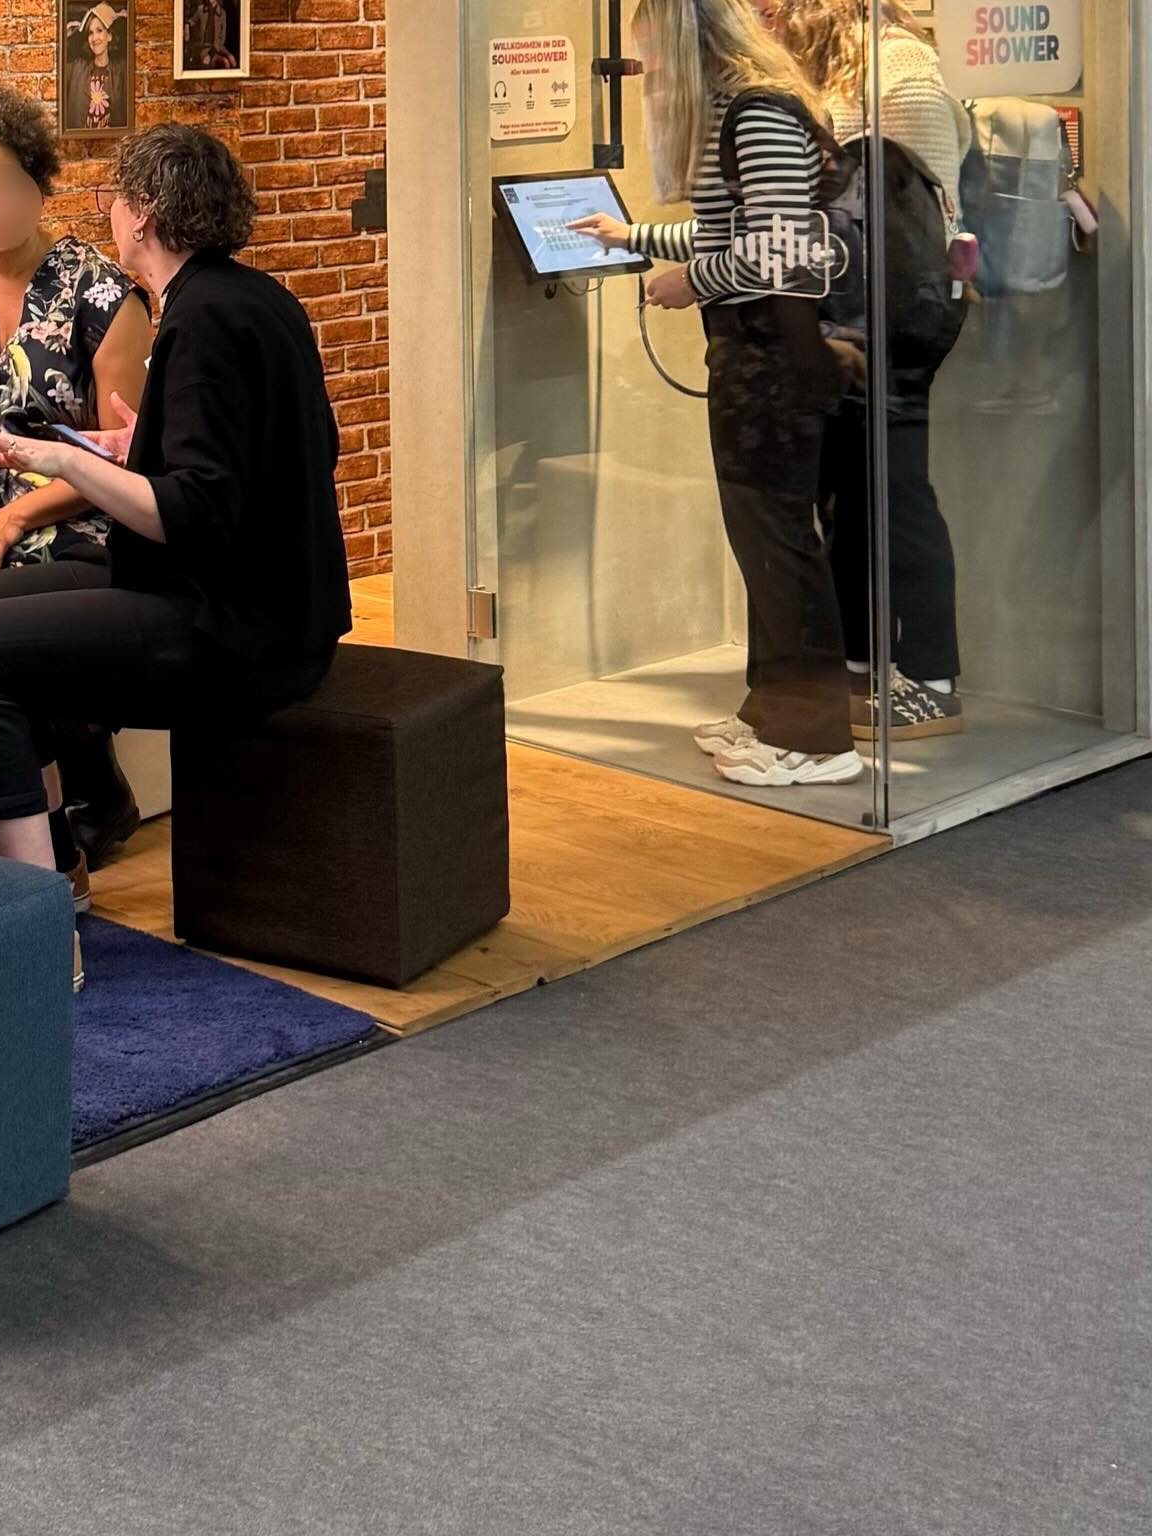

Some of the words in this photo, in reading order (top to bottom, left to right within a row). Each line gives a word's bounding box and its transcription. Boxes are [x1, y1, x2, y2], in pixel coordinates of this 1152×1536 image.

[976, 5, 1050, 34] SOUND
[493, 41, 541, 51] WILLKOMMEN
[543, 40, 551, 49] IN
[552, 40, 566, 48] DER
[967, 35, 1060, 66] SHOWER
[492, 51, 567, 65] SOUNDSHOWER!
